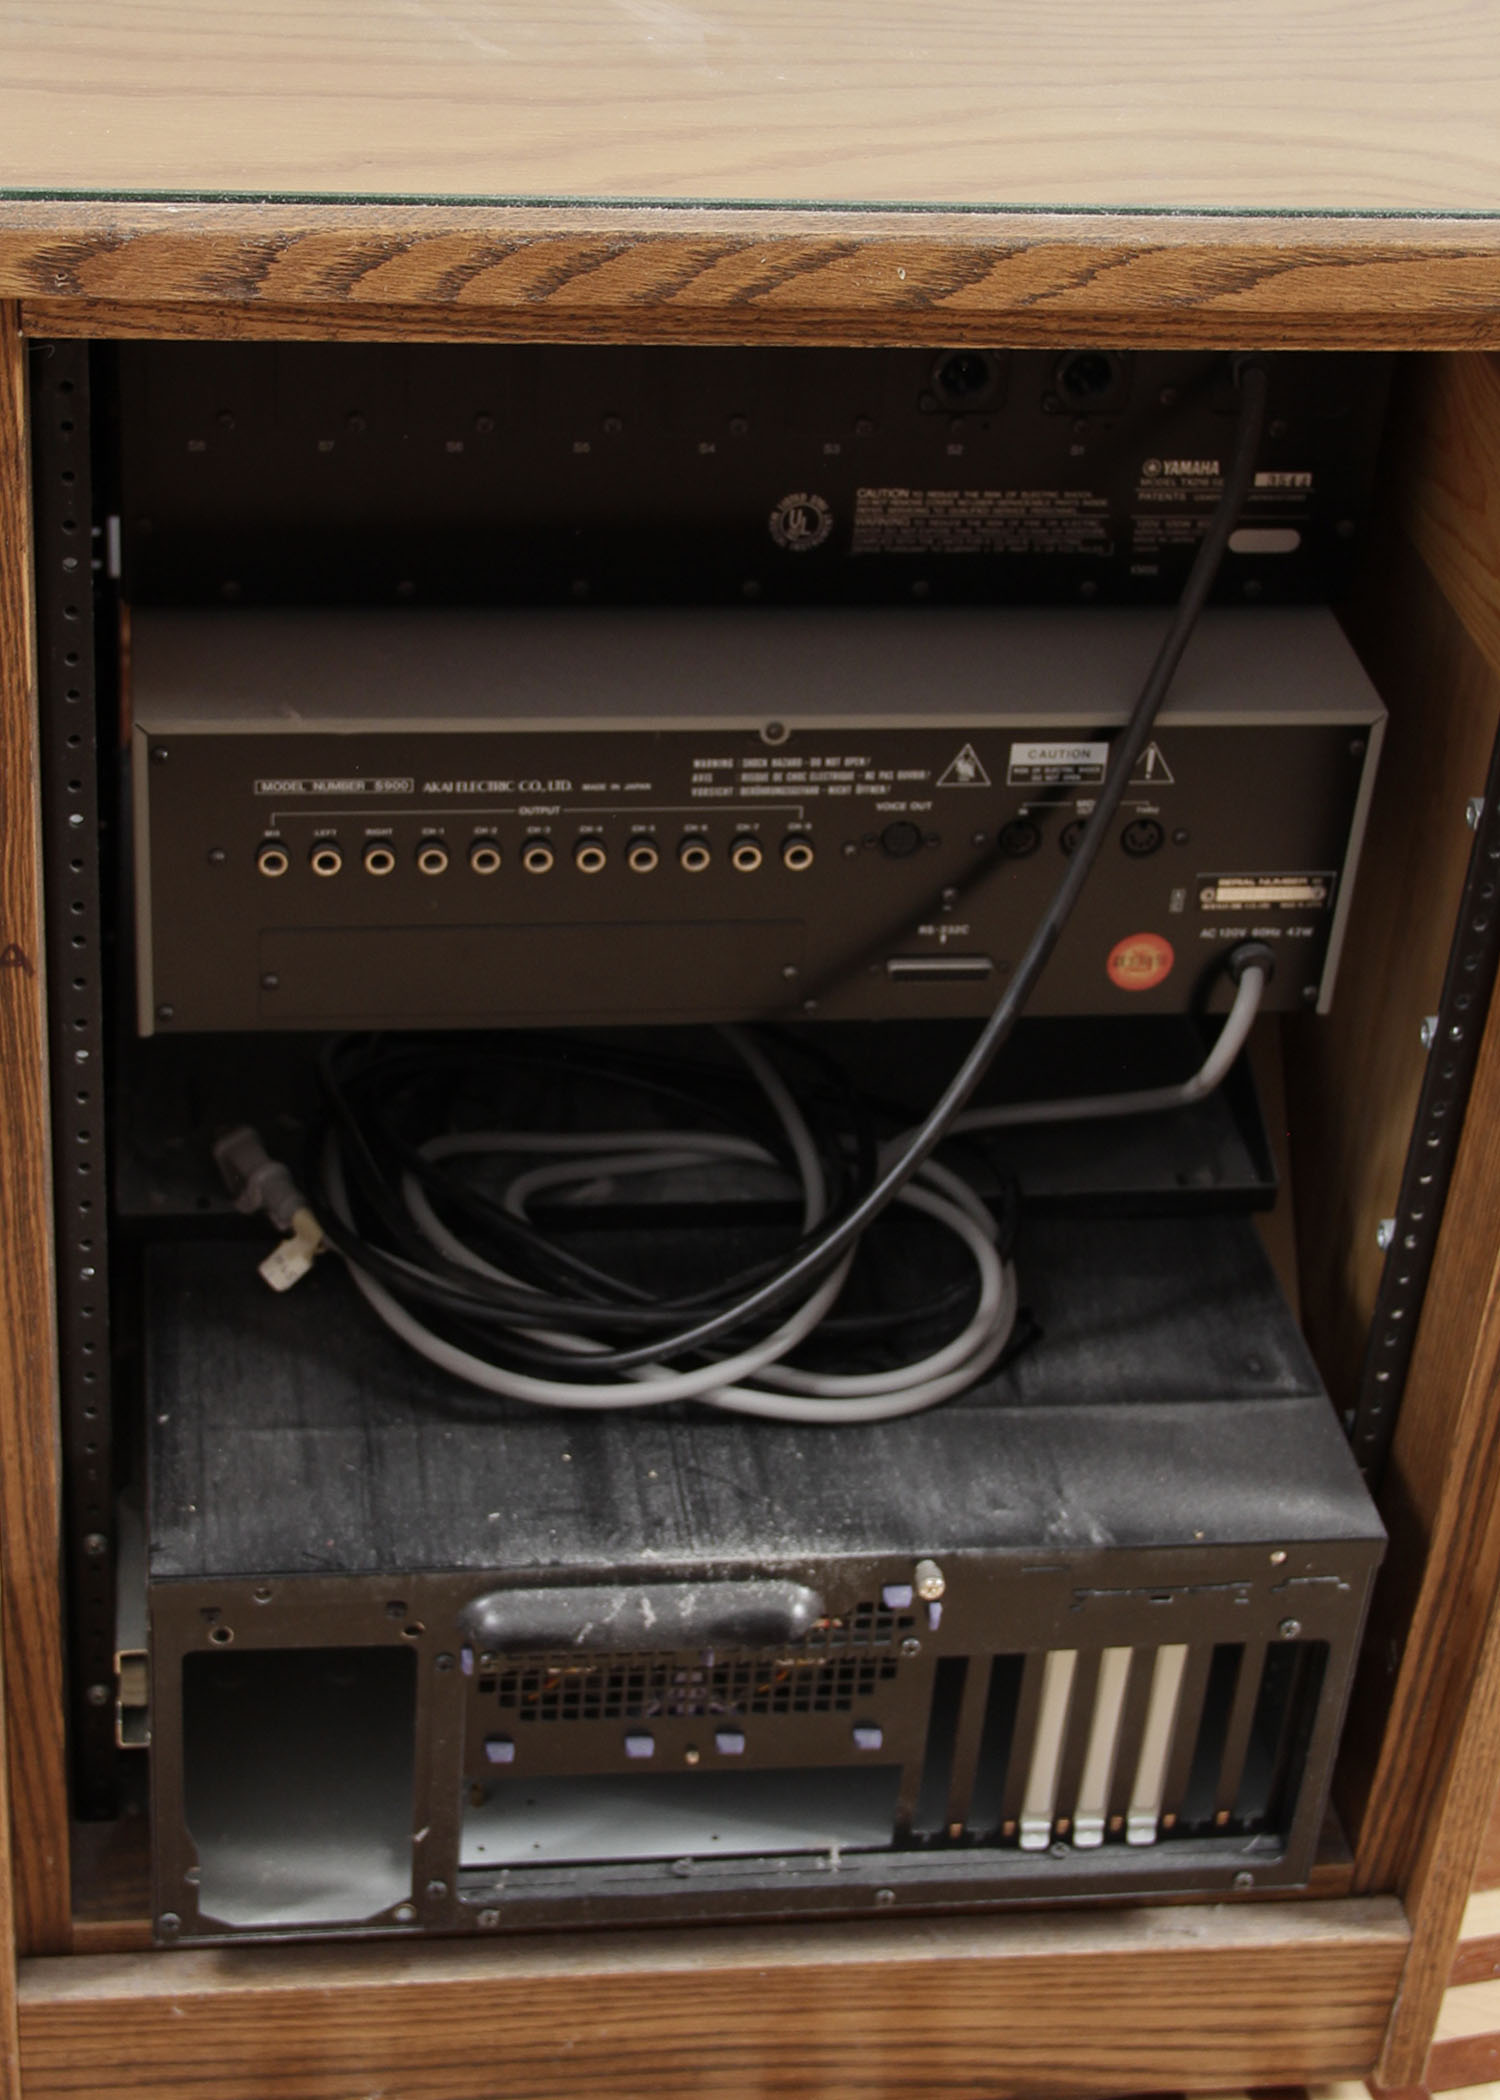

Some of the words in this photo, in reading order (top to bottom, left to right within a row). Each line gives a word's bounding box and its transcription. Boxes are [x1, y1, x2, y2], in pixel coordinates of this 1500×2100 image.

[1163, 460, 1220, 475] YAMAHA
[1140, 478, 1176, 486] MODEL
[856, 488, 909, 498] CAUTION
[1028, 749, 1092, 760] CAUTION
[692, 758, 734, 768] WARNING
[261, 781, 306, 792] MODEL
[313, 780, 365, 791] NUMBER
[423, 781, 454, 793] AKAI
[455, 780, 515, 792] ELECTRIC
[518, 806, 561, 815] OUTPUT
[876, 802, 906, 811] VOICE
[910, 801, 933, 810] OUT
[917, 924, 970, 935] RS-232C
[1200, 928, 1217, 939] AC
